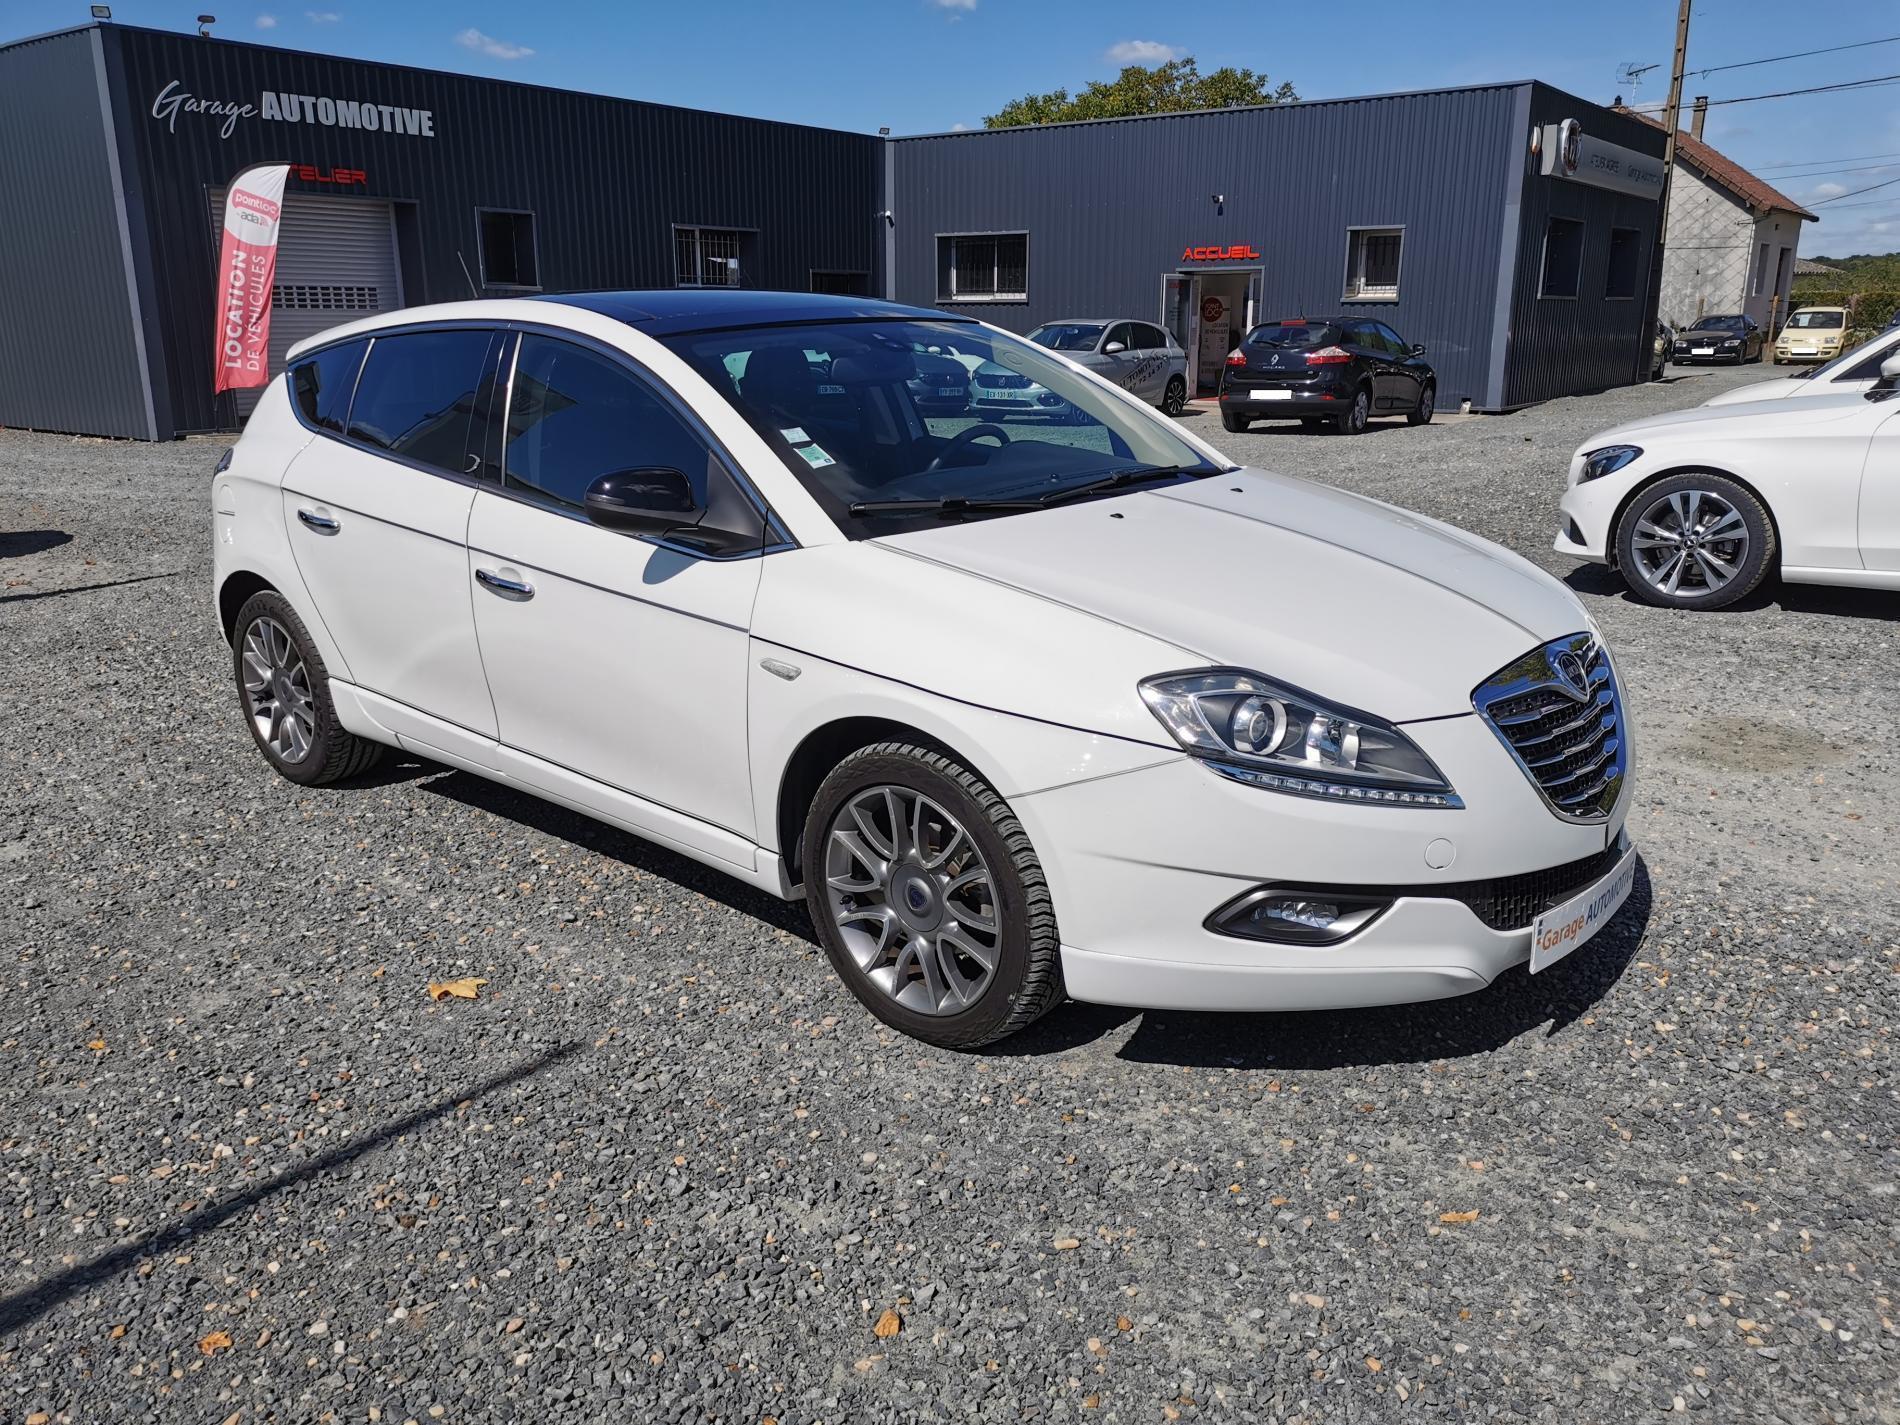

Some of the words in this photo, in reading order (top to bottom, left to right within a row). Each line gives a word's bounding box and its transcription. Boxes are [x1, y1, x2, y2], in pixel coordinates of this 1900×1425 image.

[152, 80, 258, 139] Garage
[262, 91, 435, 137] AUTOMOTIVE
[289, 164, 366, 185] TELIER
[1182, 246, 1260, 261] ACCUEIL
[225, 250, 247, 368] LOCATION
[245, 256, 266, 343] VÉHICULES
[247, 350, 260, 371] DE
[1542, 915, 1585, 950] Garage
